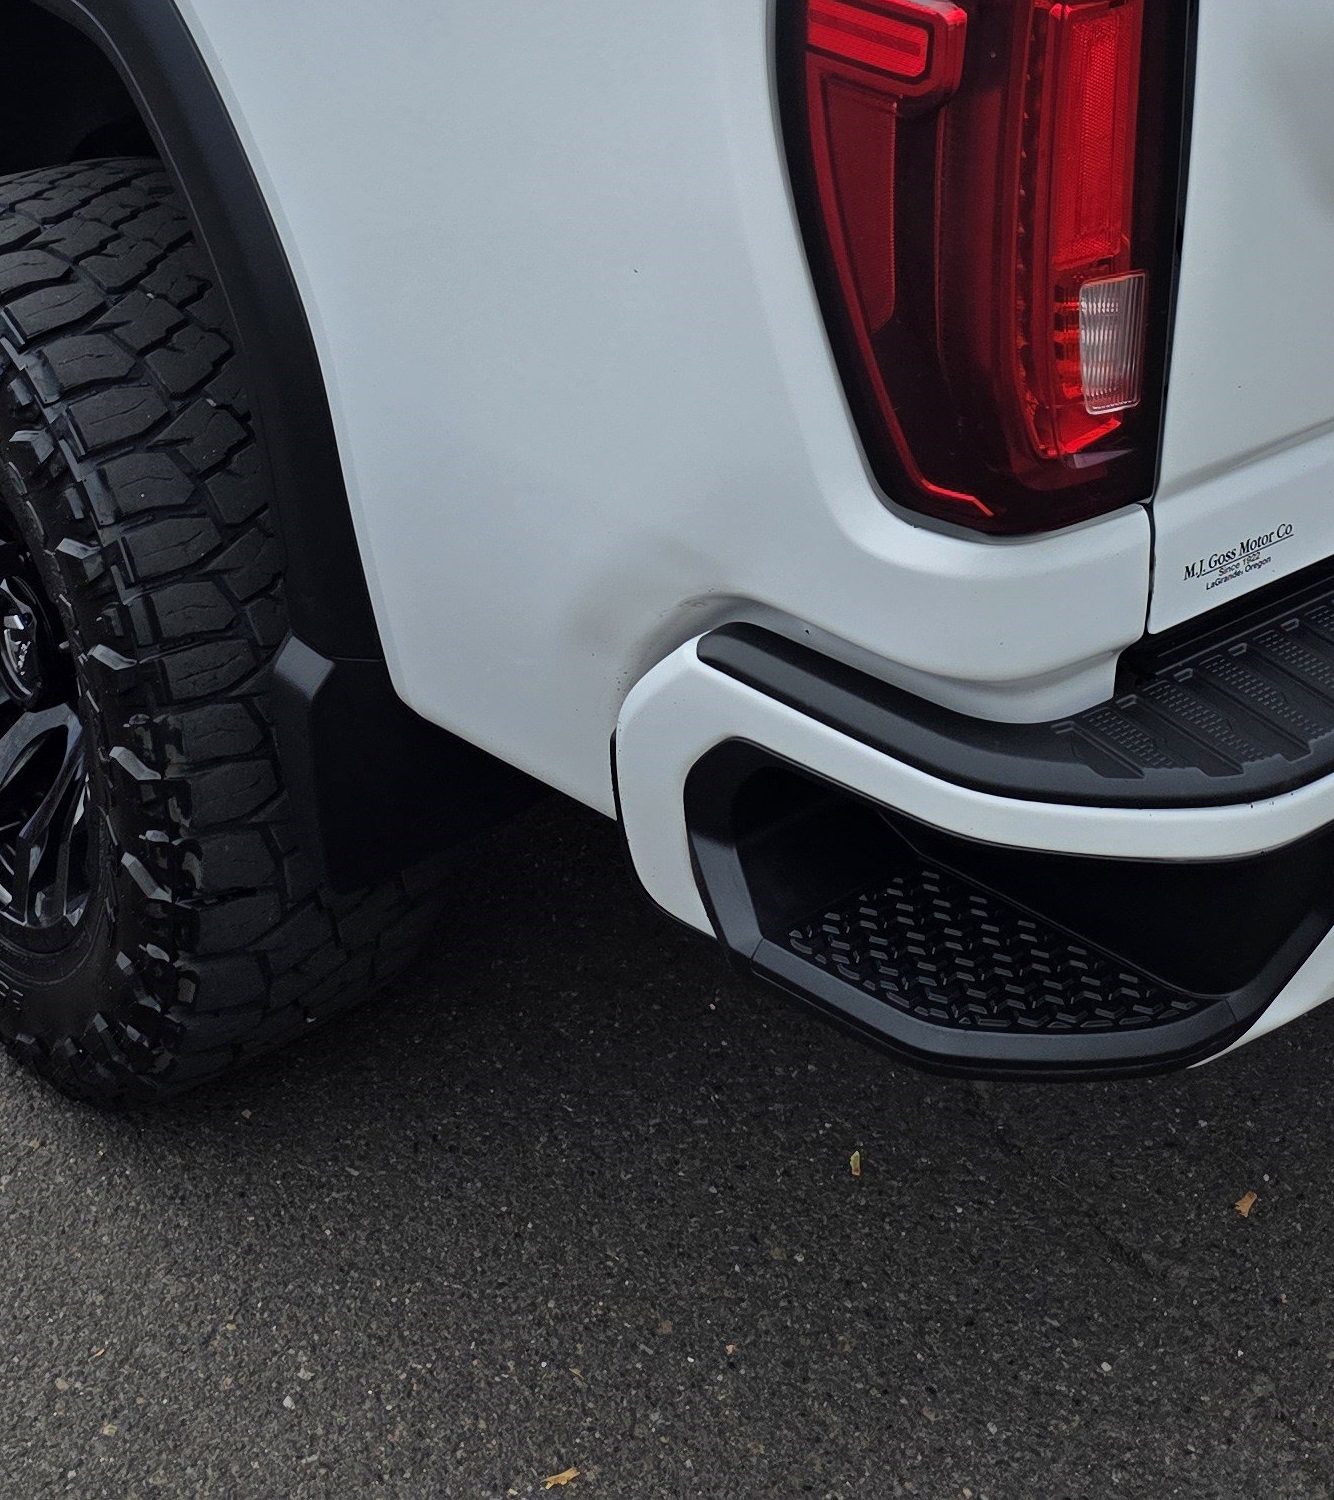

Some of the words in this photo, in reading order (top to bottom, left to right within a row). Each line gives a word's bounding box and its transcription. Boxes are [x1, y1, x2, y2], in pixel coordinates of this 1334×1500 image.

[1184, 559, 1206, 580] M.J.
[1208, 548, 1237, 569] Goss
[1238, 531, 1275, 556] Motor
[1276, 523, 1293, 539] Co
[1218, 562, 1240, 576] Since
[1242, 552, 1261, 565] 1922
[1244, 556, 1272, 573] Oregon
